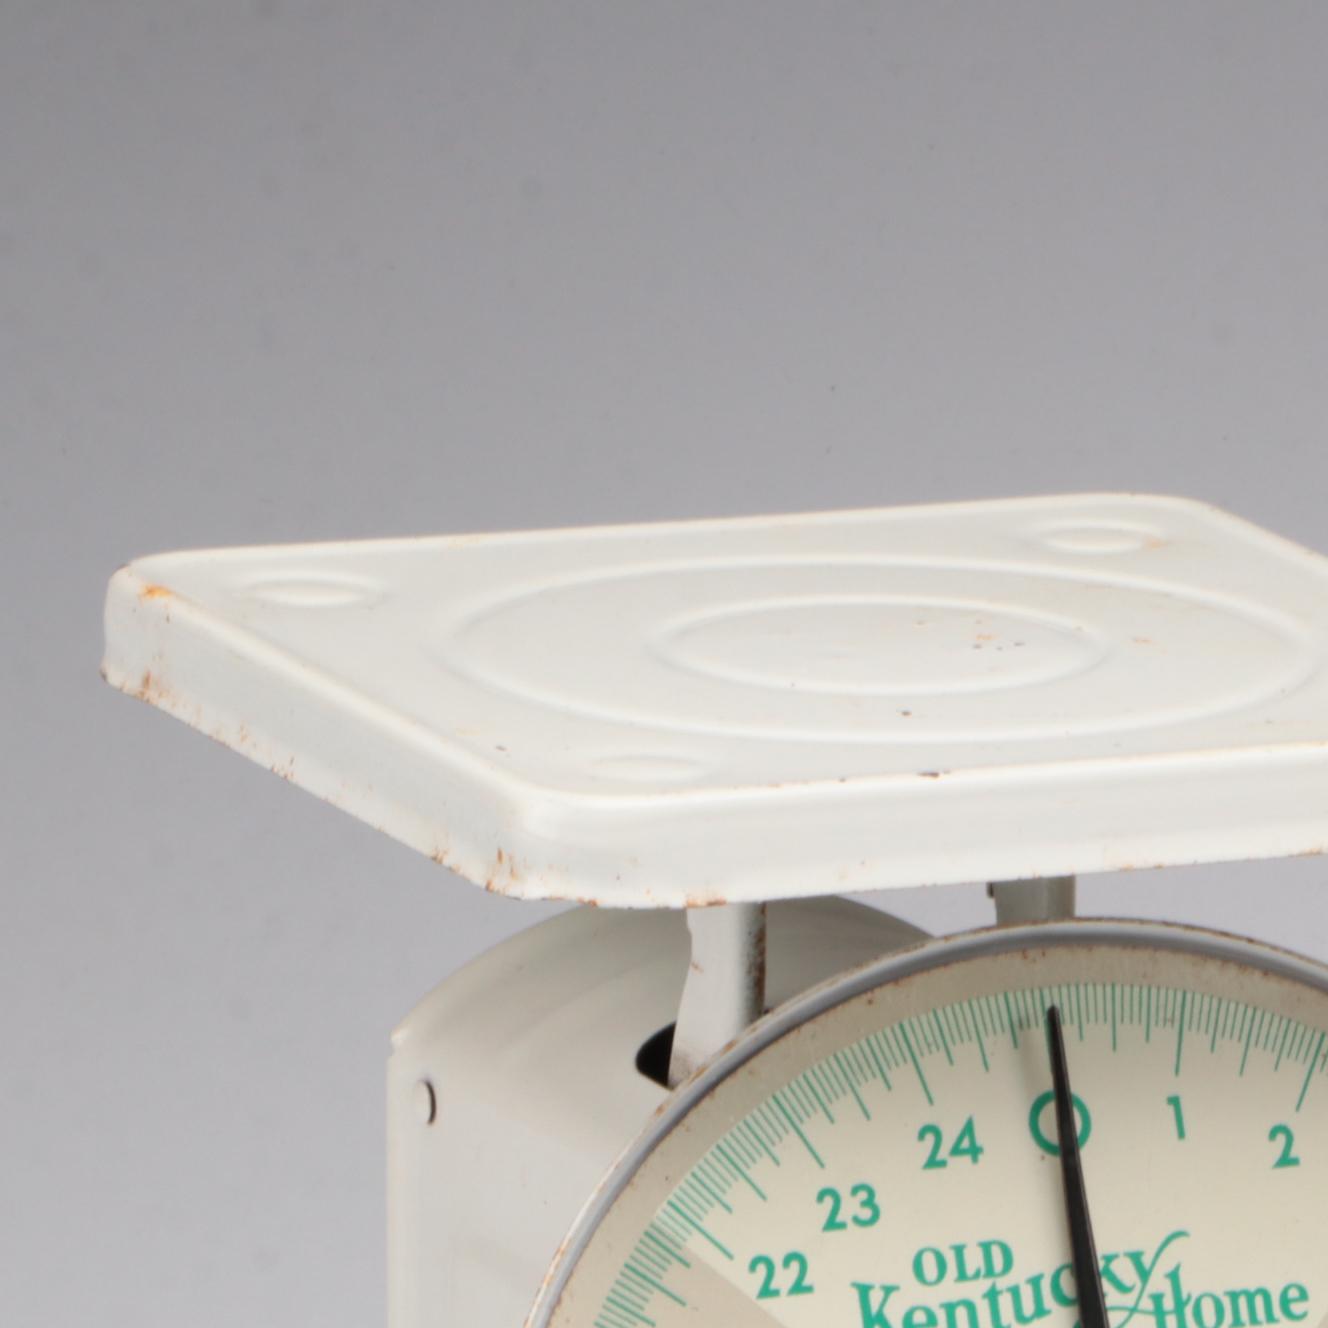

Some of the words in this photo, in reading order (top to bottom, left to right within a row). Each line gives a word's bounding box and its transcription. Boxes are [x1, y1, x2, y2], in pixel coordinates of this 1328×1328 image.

[1168, 1095, 1186, 1140] 1
[918, 1119, 984, 1169] 24
[1268, 1124, 1300, 1168] 2
[816, 1183, 881, 1232] 23
[748, 1250, 815, 1300] 22
[912, 1239, 1014, 1287] OLD
